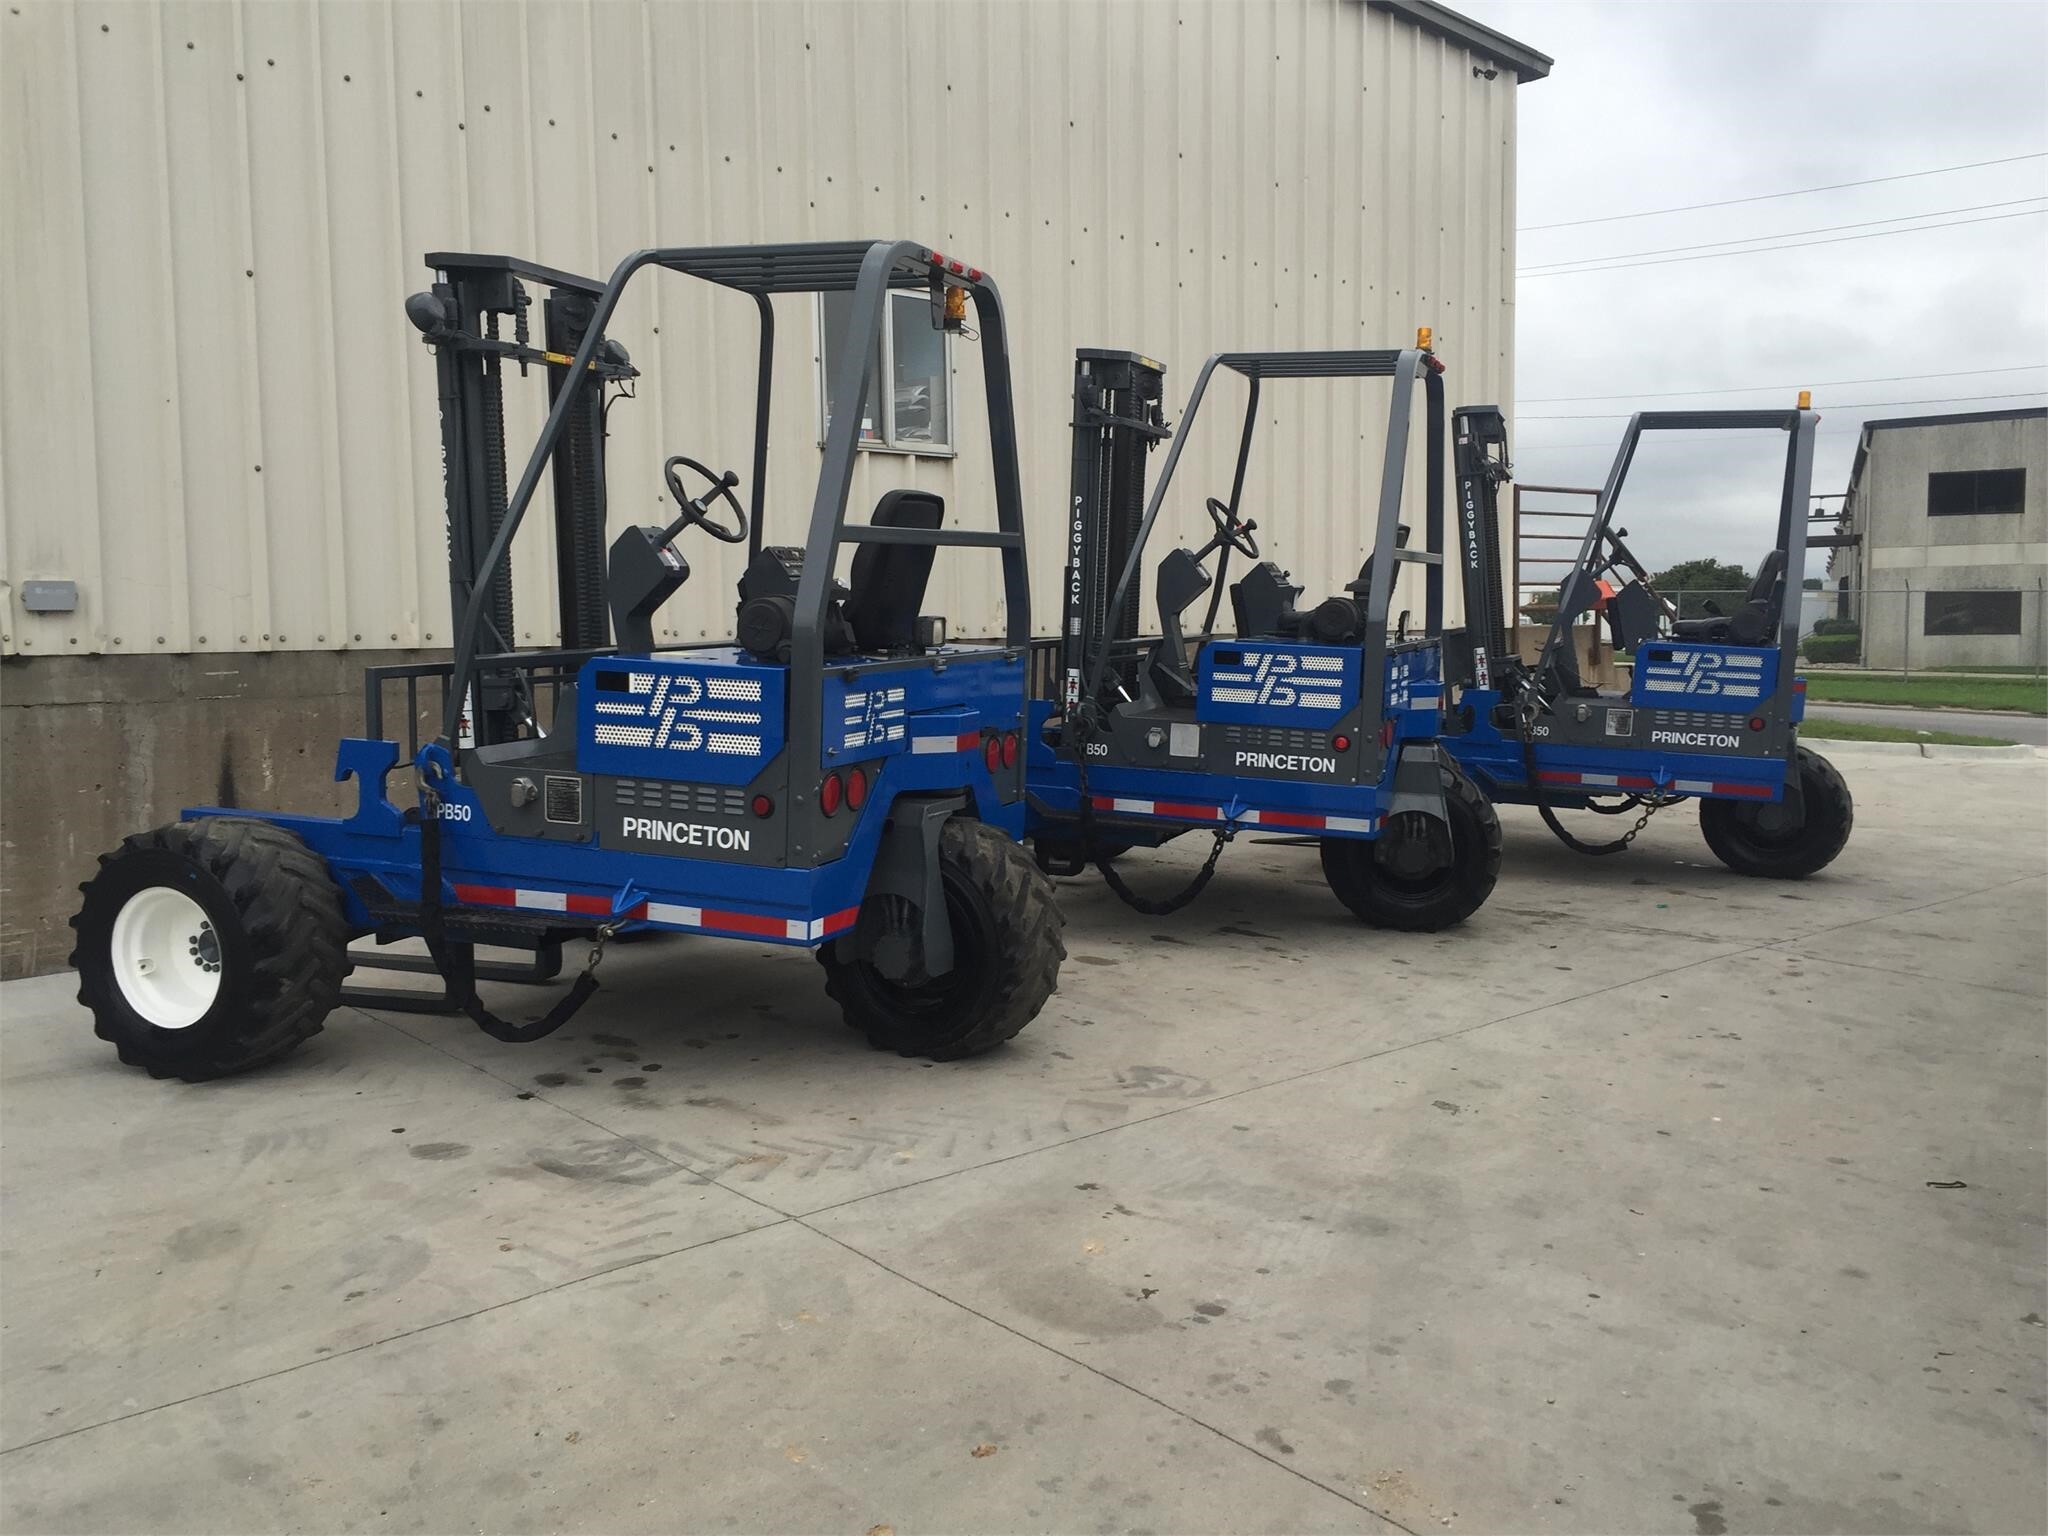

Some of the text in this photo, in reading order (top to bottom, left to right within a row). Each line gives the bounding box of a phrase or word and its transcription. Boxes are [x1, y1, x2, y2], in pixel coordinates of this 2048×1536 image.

[1464, 481, 1478, 569] PIGGYBACK
[1071, 495, 1083, 605] PIGGYBACK
[1651, 731, 1740, 748] PRINCETON
[1235, 751, 1336, 773] PRINCETON
[436, 803, 472, 822] PB50
[623, 816, 750, 851] PRINCETON
